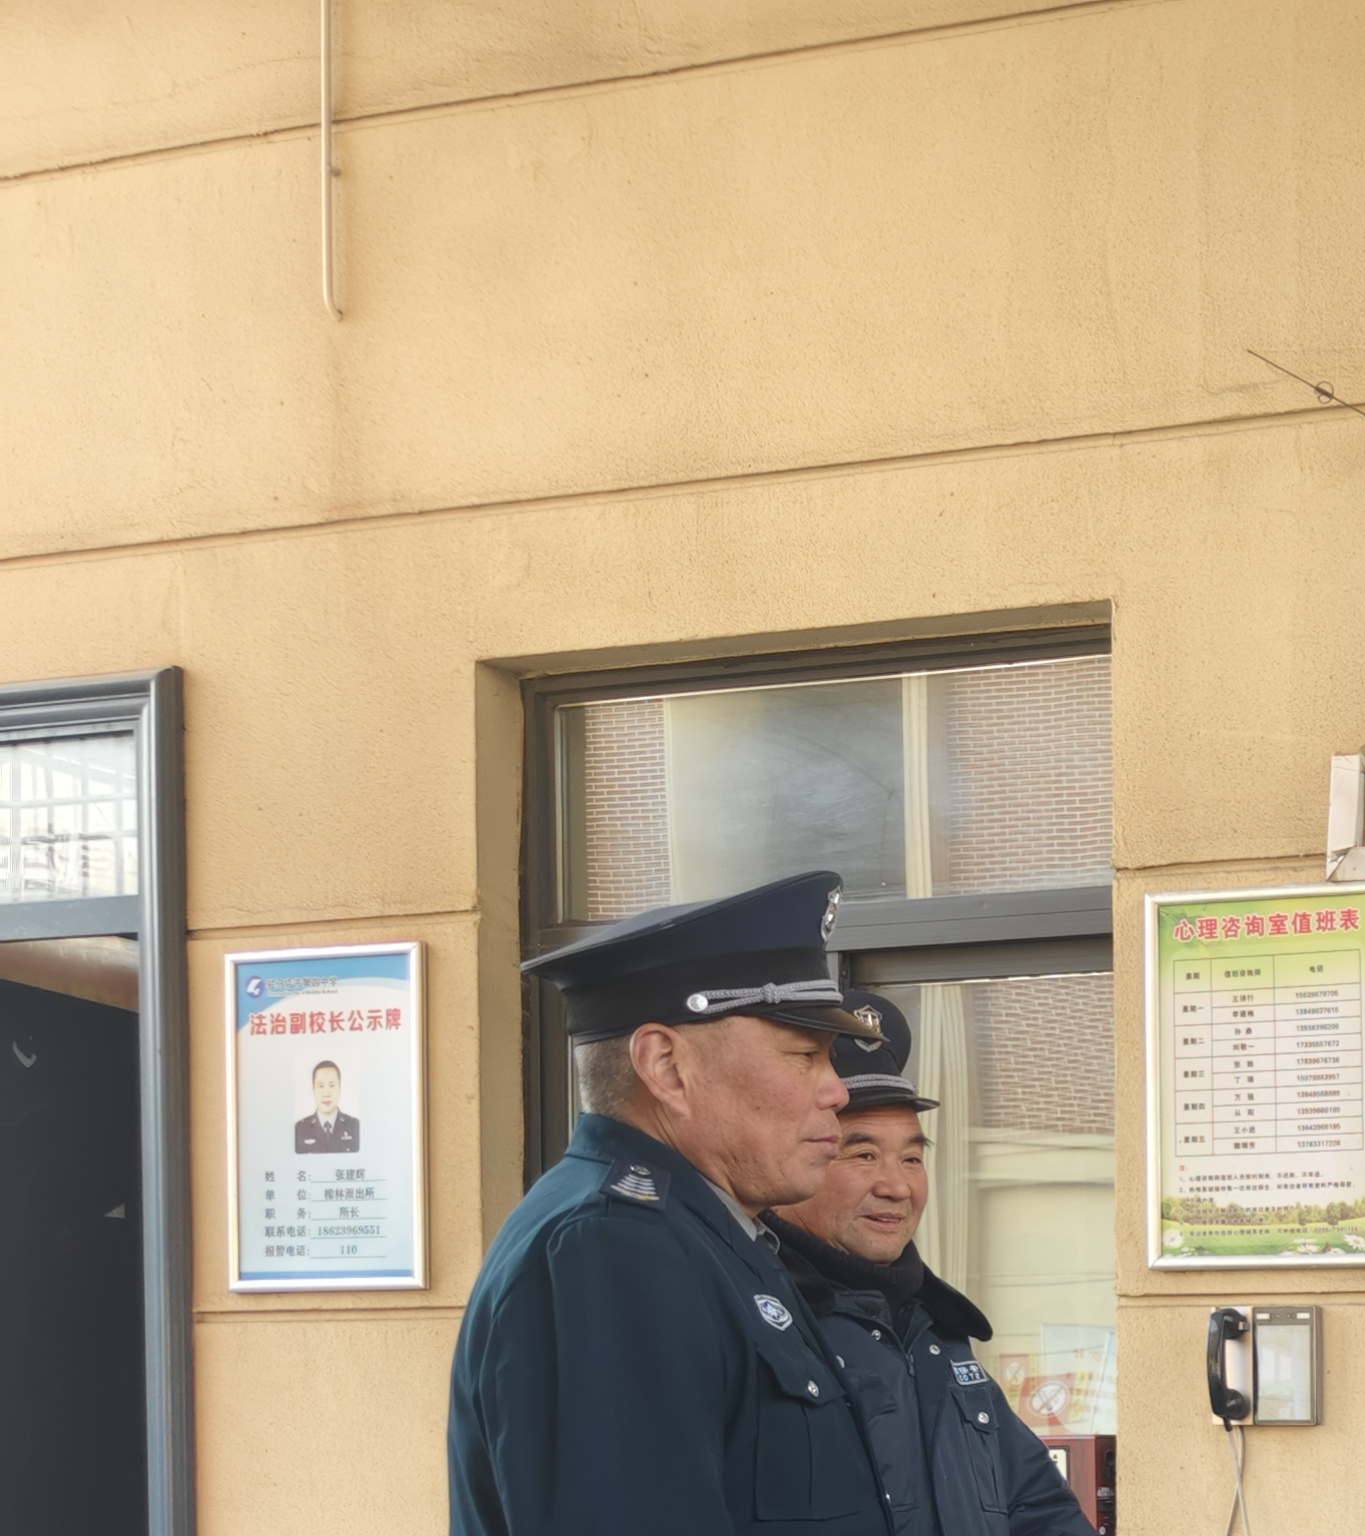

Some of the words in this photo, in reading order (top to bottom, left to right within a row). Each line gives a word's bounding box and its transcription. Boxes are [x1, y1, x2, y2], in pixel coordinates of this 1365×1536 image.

[1174, 908, 1360, 942] 心理咨询室值班表
[250, 1008, 402, 1036] 法治副校长公示牌
[317, 1225, 381, 1237] 18623969551
[340, 1244, 358, 1255] 110
